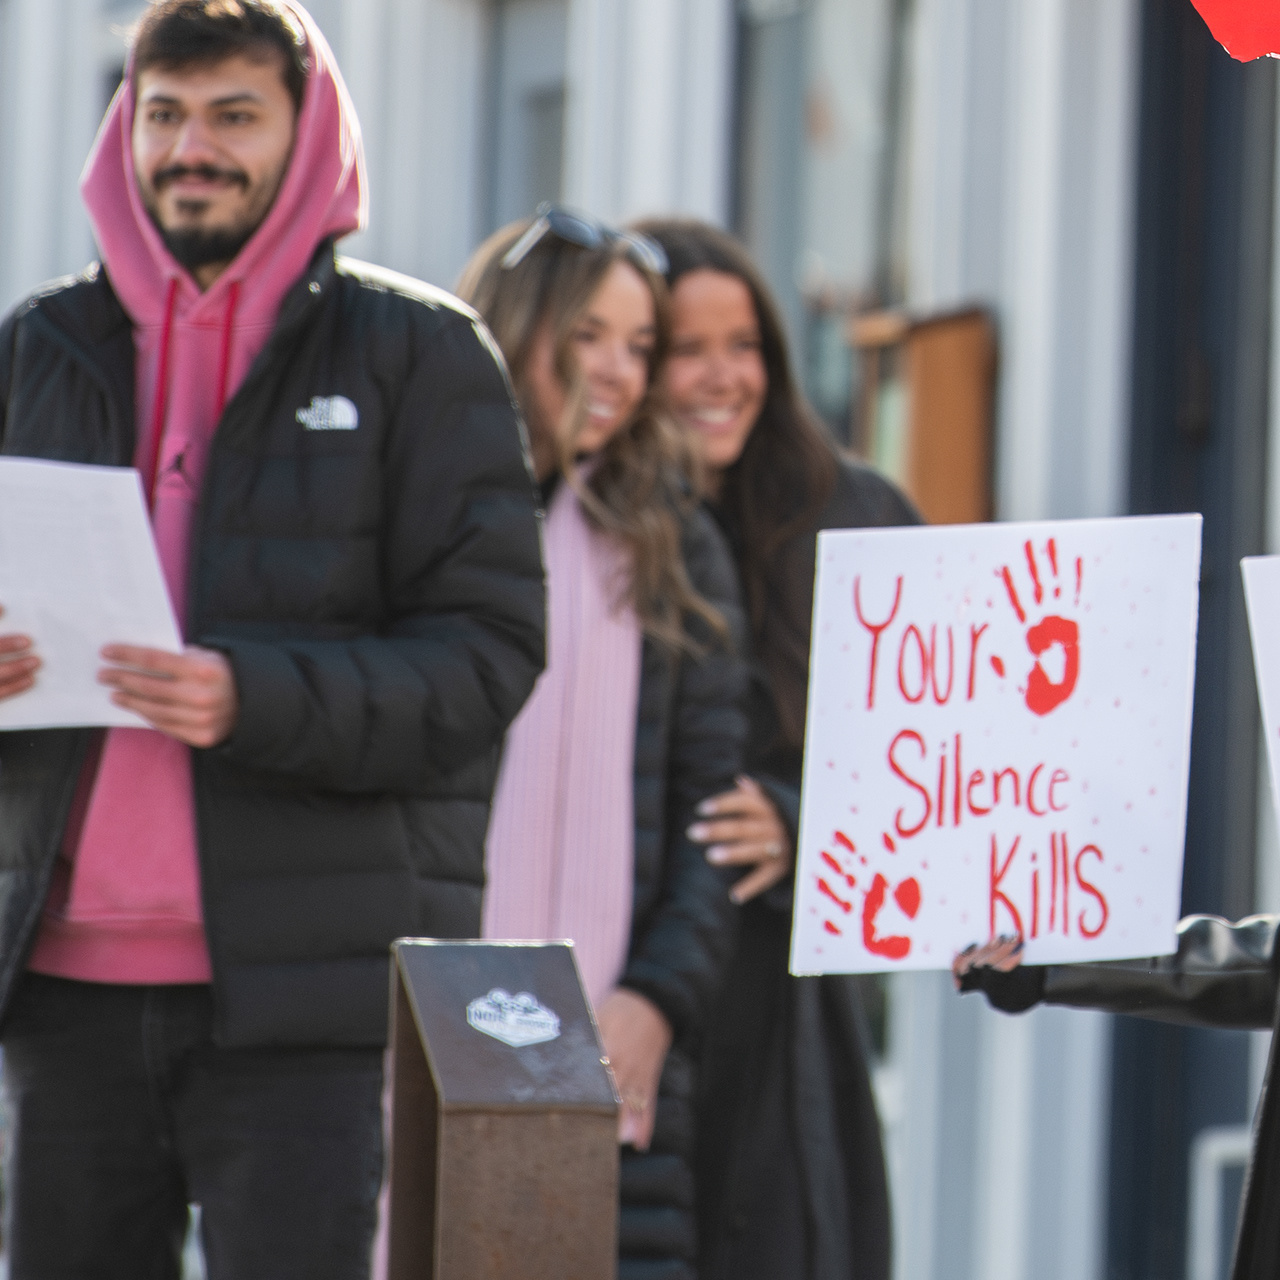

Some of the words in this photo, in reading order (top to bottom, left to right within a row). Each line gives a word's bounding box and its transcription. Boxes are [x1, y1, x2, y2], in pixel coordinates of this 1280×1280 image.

[854, 574, 990, 711] Your
[887, 729, 1071, 839] Silence
[989, 831, 1109, 944] Kills
